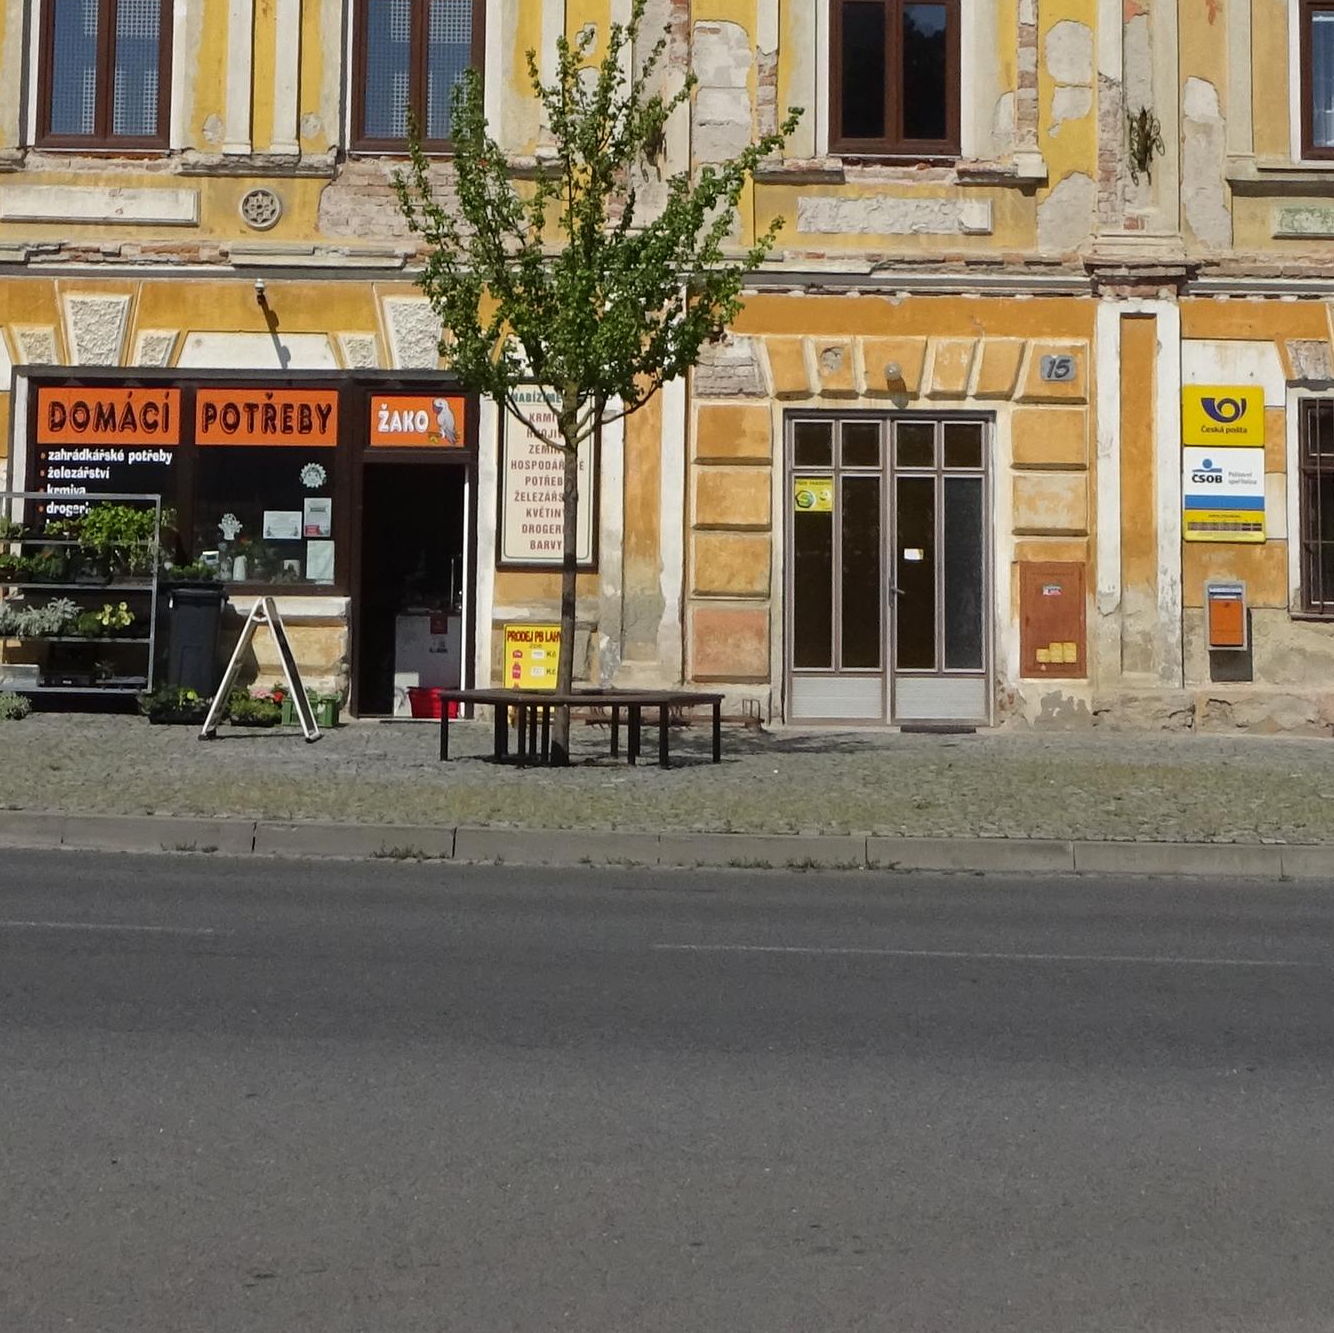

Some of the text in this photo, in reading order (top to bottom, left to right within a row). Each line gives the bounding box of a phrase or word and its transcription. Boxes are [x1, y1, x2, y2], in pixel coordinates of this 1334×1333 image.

[1047, 358, 1071, 378] 15
[511, 390, 562, 403] NABÍZME
[48, 391, 332, 435] DOMÁCÍ POTŘEBY
[378, 403, 429, 434] ŽAKO
[48, 448, 173, 465] zahrádkářské potřeby
[510, 458, 585, 471] HOSPODÁŘÉ
[47, 466, 110, 479] železářství
[1192, 474, 1223, 484] ČSOB
[525, 475, 564, 487] POTŘEB
[526, 507, 565, 518] KVĚTIN
[530, 540, 563, 551] BARVY
